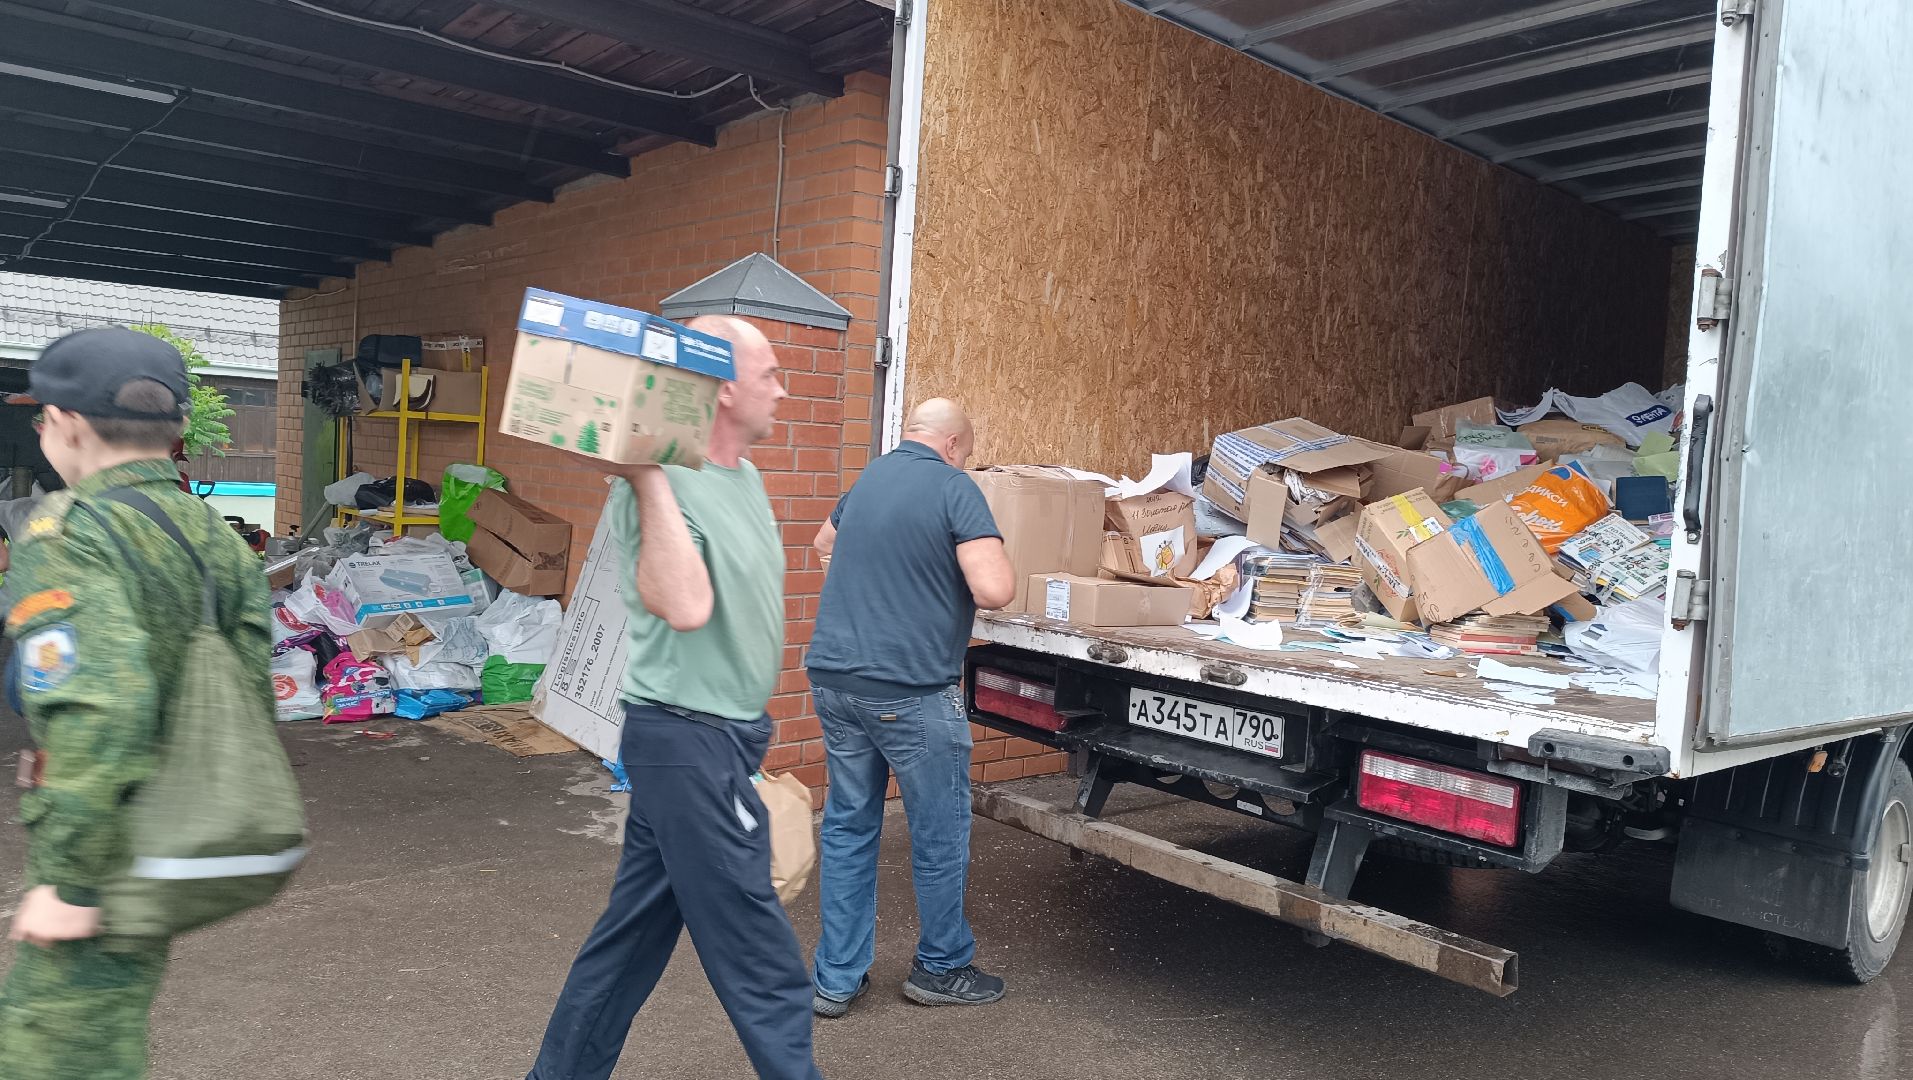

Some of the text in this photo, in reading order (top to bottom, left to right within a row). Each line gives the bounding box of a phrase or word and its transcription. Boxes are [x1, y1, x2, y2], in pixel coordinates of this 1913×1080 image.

[1639, 407, 1668, 422] ЛЕНТА
[554, 635, 577, 687] Logistics
[574, 623, 606, 699] 352176_2007
[1235, 711, 1275, 742] 790
[1244, 738, 1264, 750] RUS
